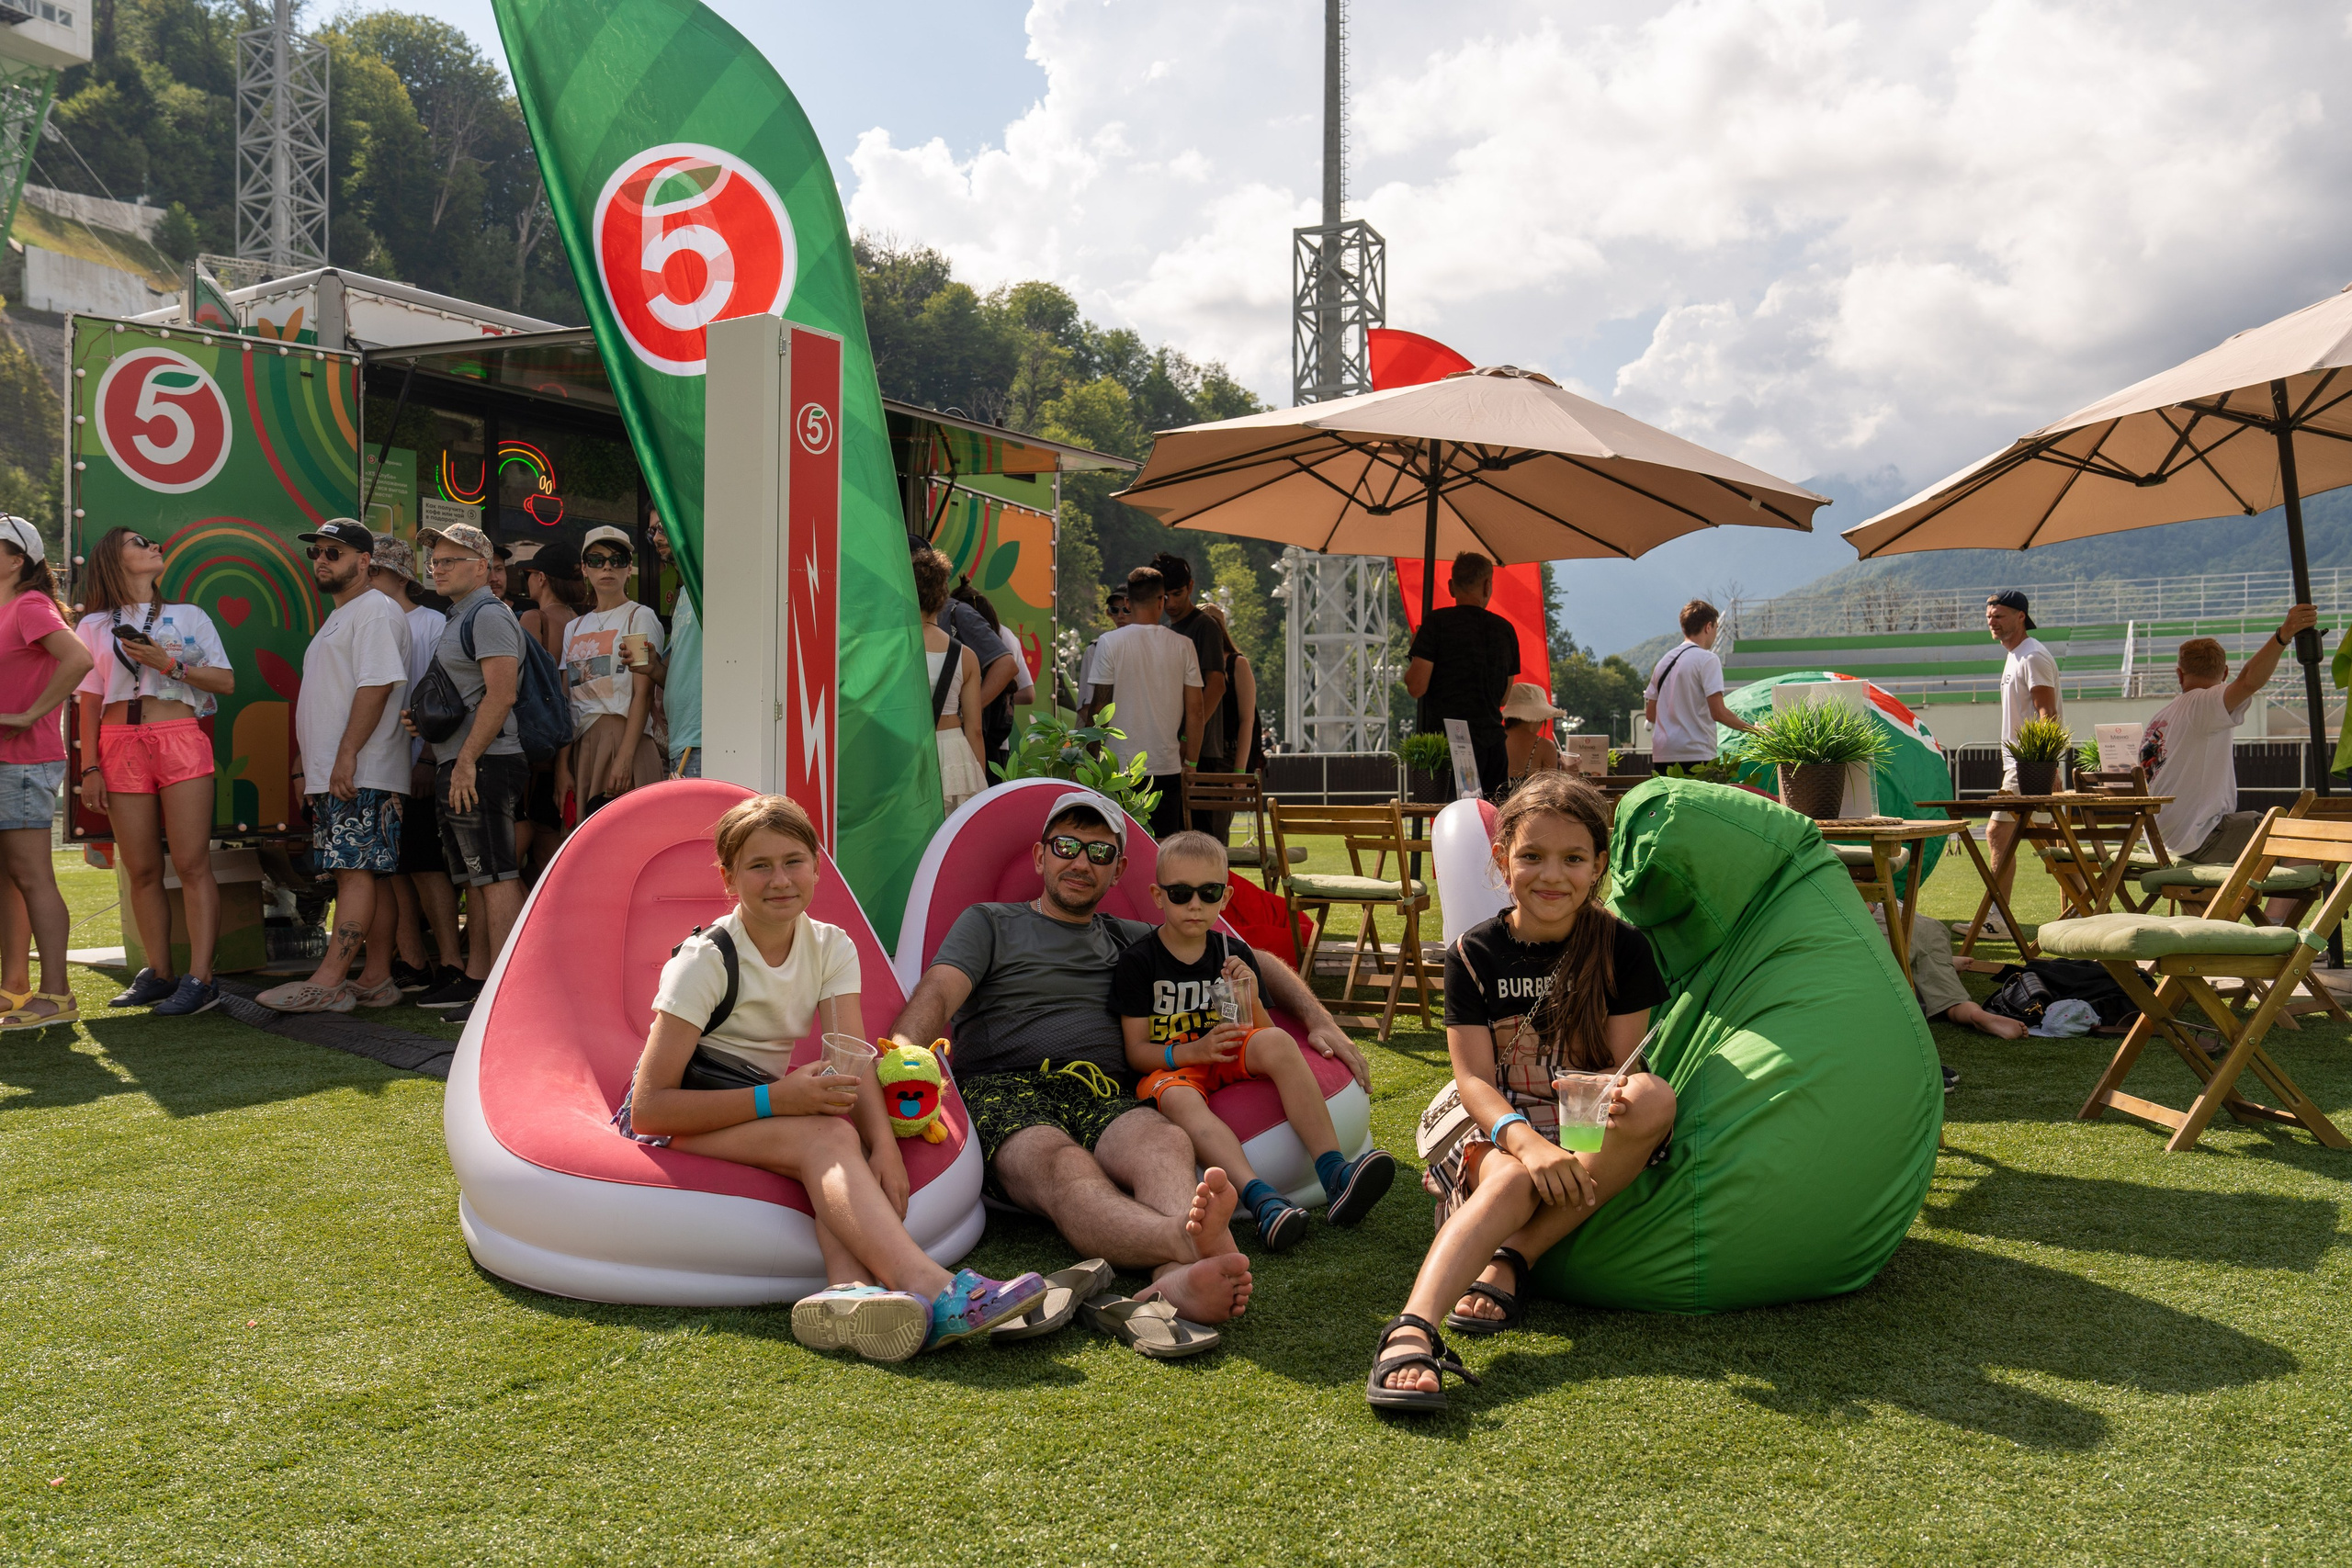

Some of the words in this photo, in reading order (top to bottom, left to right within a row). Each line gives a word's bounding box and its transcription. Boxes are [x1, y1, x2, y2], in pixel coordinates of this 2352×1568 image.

[131, 364, 206, 465] 5
[806, 408, 825, 445] 5
[430, 515, 458, 524] подарок?
[437, 505, 465, 513] получить
[1498, 976, 1572, 998] BURBE
